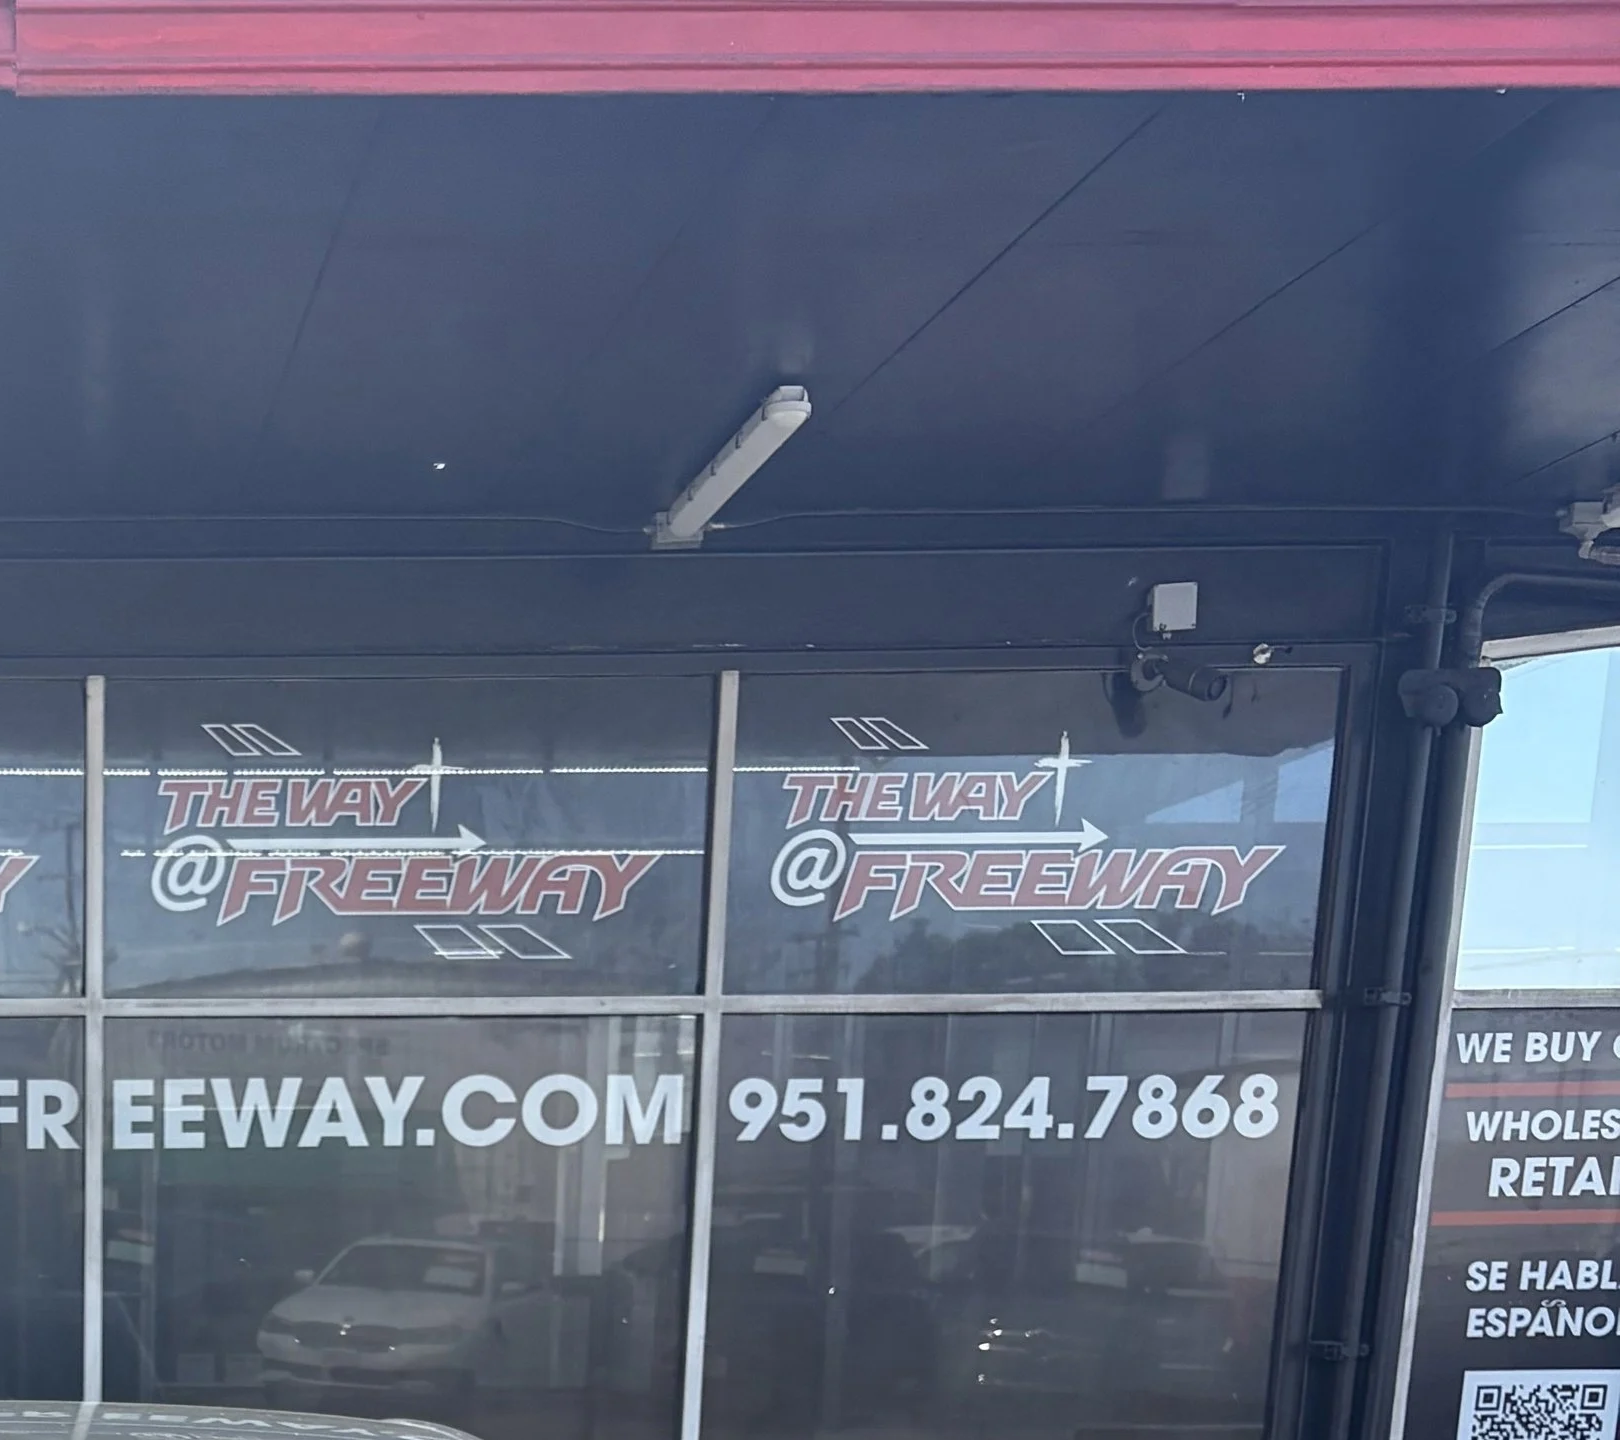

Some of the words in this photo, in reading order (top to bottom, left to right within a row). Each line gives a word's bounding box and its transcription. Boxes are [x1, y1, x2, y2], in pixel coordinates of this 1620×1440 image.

[1456, 1031, 1514, 1065] WE
[1524, 1031, 1602, 1063] BUY
[728, 1073, 1281, 1143] 951.824.7868
[1466, 1261, 1507, 1293] SE
[1520, 1259, 1620, 1292] HABL
